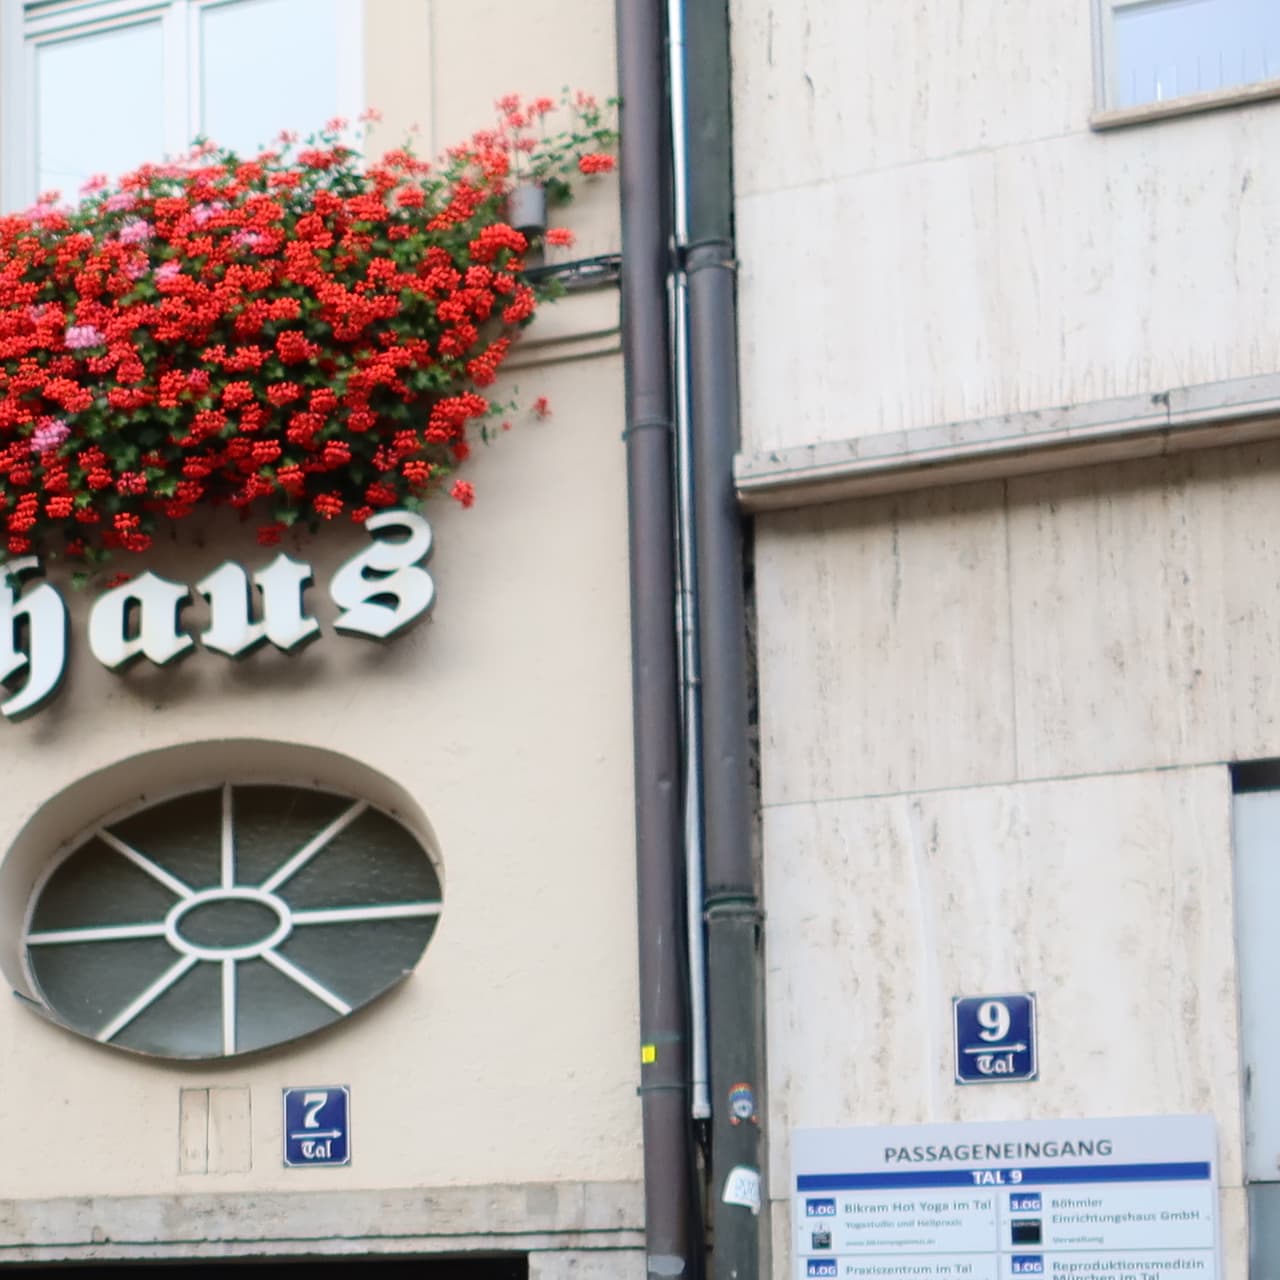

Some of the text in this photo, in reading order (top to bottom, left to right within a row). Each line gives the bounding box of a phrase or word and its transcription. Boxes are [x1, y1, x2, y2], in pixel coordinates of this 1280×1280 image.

[977, 1001, 1010, 1042] 9
[976, 1053, 1015, 1075] Tal
[303, 1092, 328, 1128] 7
[301, 1140, 332, 1159] Tal
[885, 1139, 1113, 1164] PASSAGENEINGANG
[971, 1170, 1023, 1185] TAL 9
[844, 1200, 992, 1214] Bikram Hot Yoga im Tal
[1052, 1213, 1157, 1225] Einrichtungshaus
[1161, 1211, 1200, 1221] GmbH
[846, 1264, 972, 1275] Praxiszentrum im Tal
[1052, 1260, 1204, 1272] Reproduktionsmedizin
